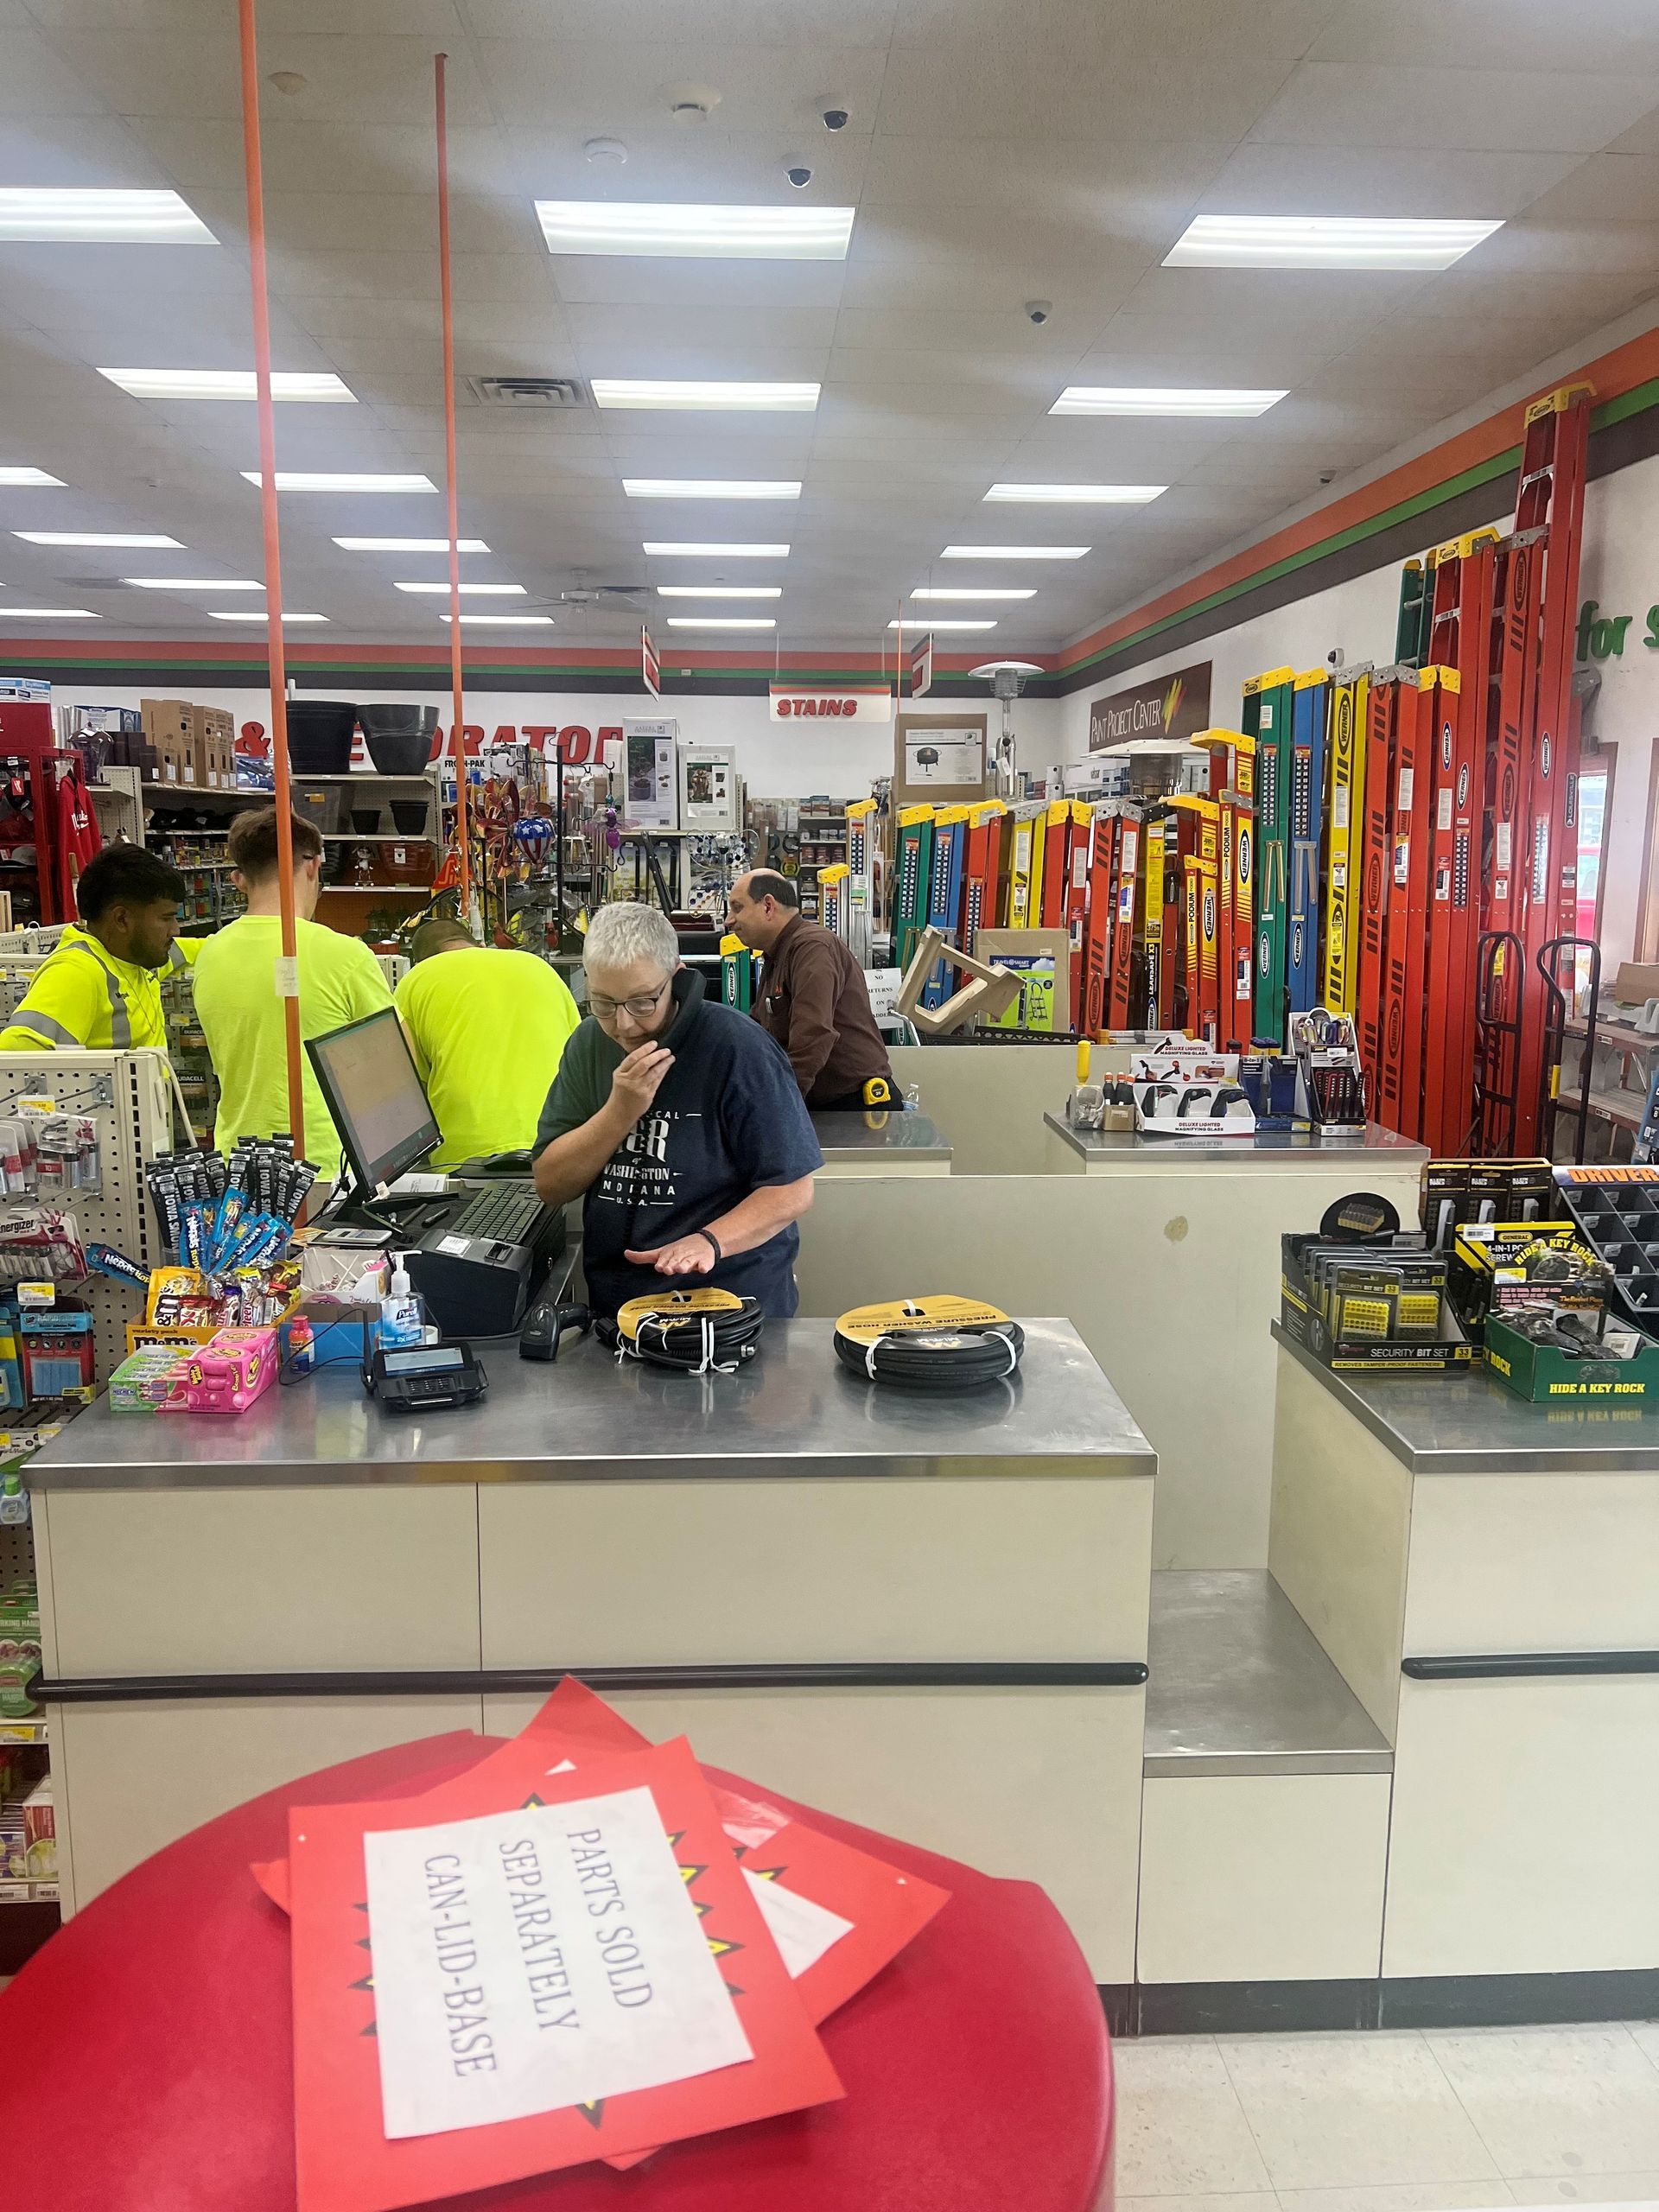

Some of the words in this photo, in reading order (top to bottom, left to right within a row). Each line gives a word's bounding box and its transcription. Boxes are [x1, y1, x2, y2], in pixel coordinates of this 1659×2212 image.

[1575, 600, 1632, 661] for
[777, 699, 858, 716] STAINS
[1091, 716, 1107, 743] PAINT
[1107, 709, 1133, 739] PROJECT
[1133, 699, 1161, 731] CENTER
[234, 721, 270, 760] &
[445, 760, 485, 768] FROH-PAK
[1149, 944, 1155, 954] X3
[260, 1169, 270, 1196] IOWA
[604, 1163, 671, 1180] WASHIGTON
[277, 1181, 287, 1207] IOWA
[603, 1180, 675, 1195] NDIANA
[164, 1194, 178, 1221] IOWA
[288, 1188, 305, 1214] IOWA
[0, 1220, 34, 1233] nergizer
[1514, 1244, 1538, 1265] HIDE
[1549, 1239, 1570, 1249] KEY
[398, 1306, 418, 1318] Purell
[935, 1315, 996, 1324] PRESSURE
[1370, 1349, 1415, 1358] SECURITY
[1417, 1349, 1432, 1357] BIT
[1433, 1349, 1449, 1357] SET
[1491, 1353, 1511, 1376] ROCK
[1549, 1383, 1577, 1393] HIDE
[1578, 1383, 1587, 1393] A
[1589, 1383, 1613, 1393] KEY
[1613, 1383, 1645, 1393] ROCK
[566, 1827, 625, 1919] PARTS
[597, 1923, 654, 2010] SOLD
[498, 1838, 581, 2033] SEPARATELY
[424, 1853, 498, 2077] CAN-LID-BASE
